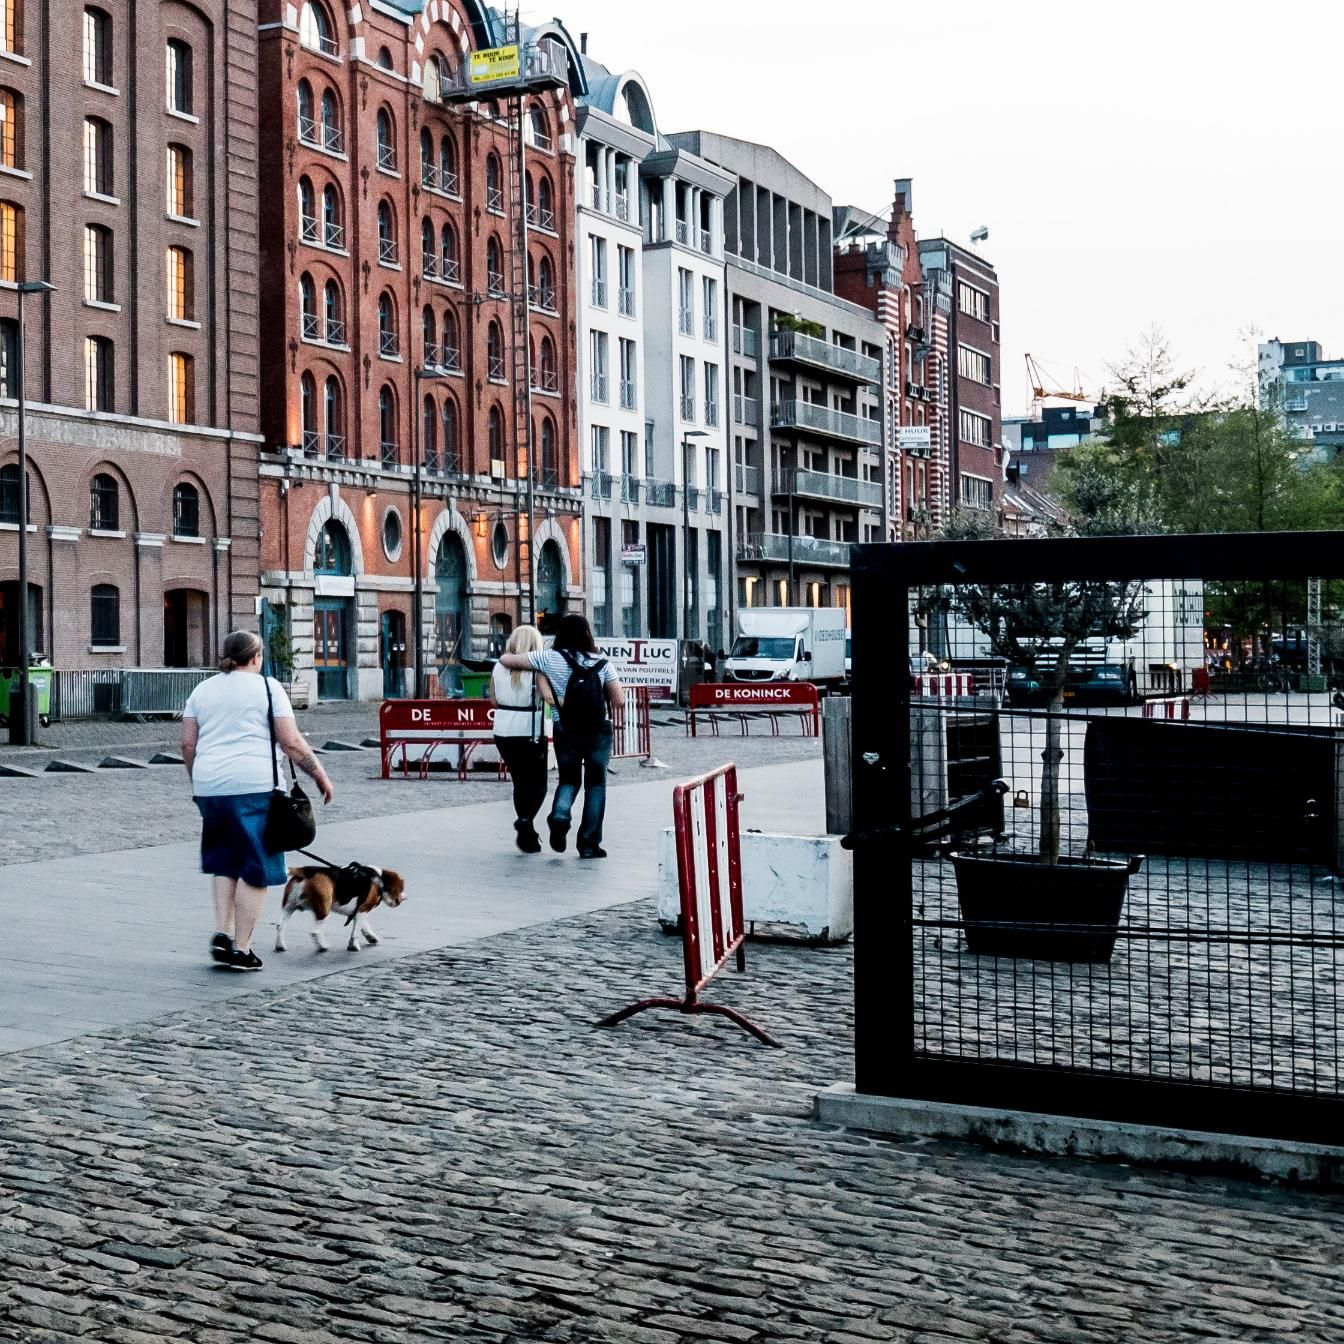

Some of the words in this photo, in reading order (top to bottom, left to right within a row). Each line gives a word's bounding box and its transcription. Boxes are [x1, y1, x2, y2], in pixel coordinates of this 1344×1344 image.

[643, 647, 671, 658] LUC
[715, 689, 731, 699] DE
[733, 688, 792, 698] KONINCK
[411, 708, 432, 721] DE
